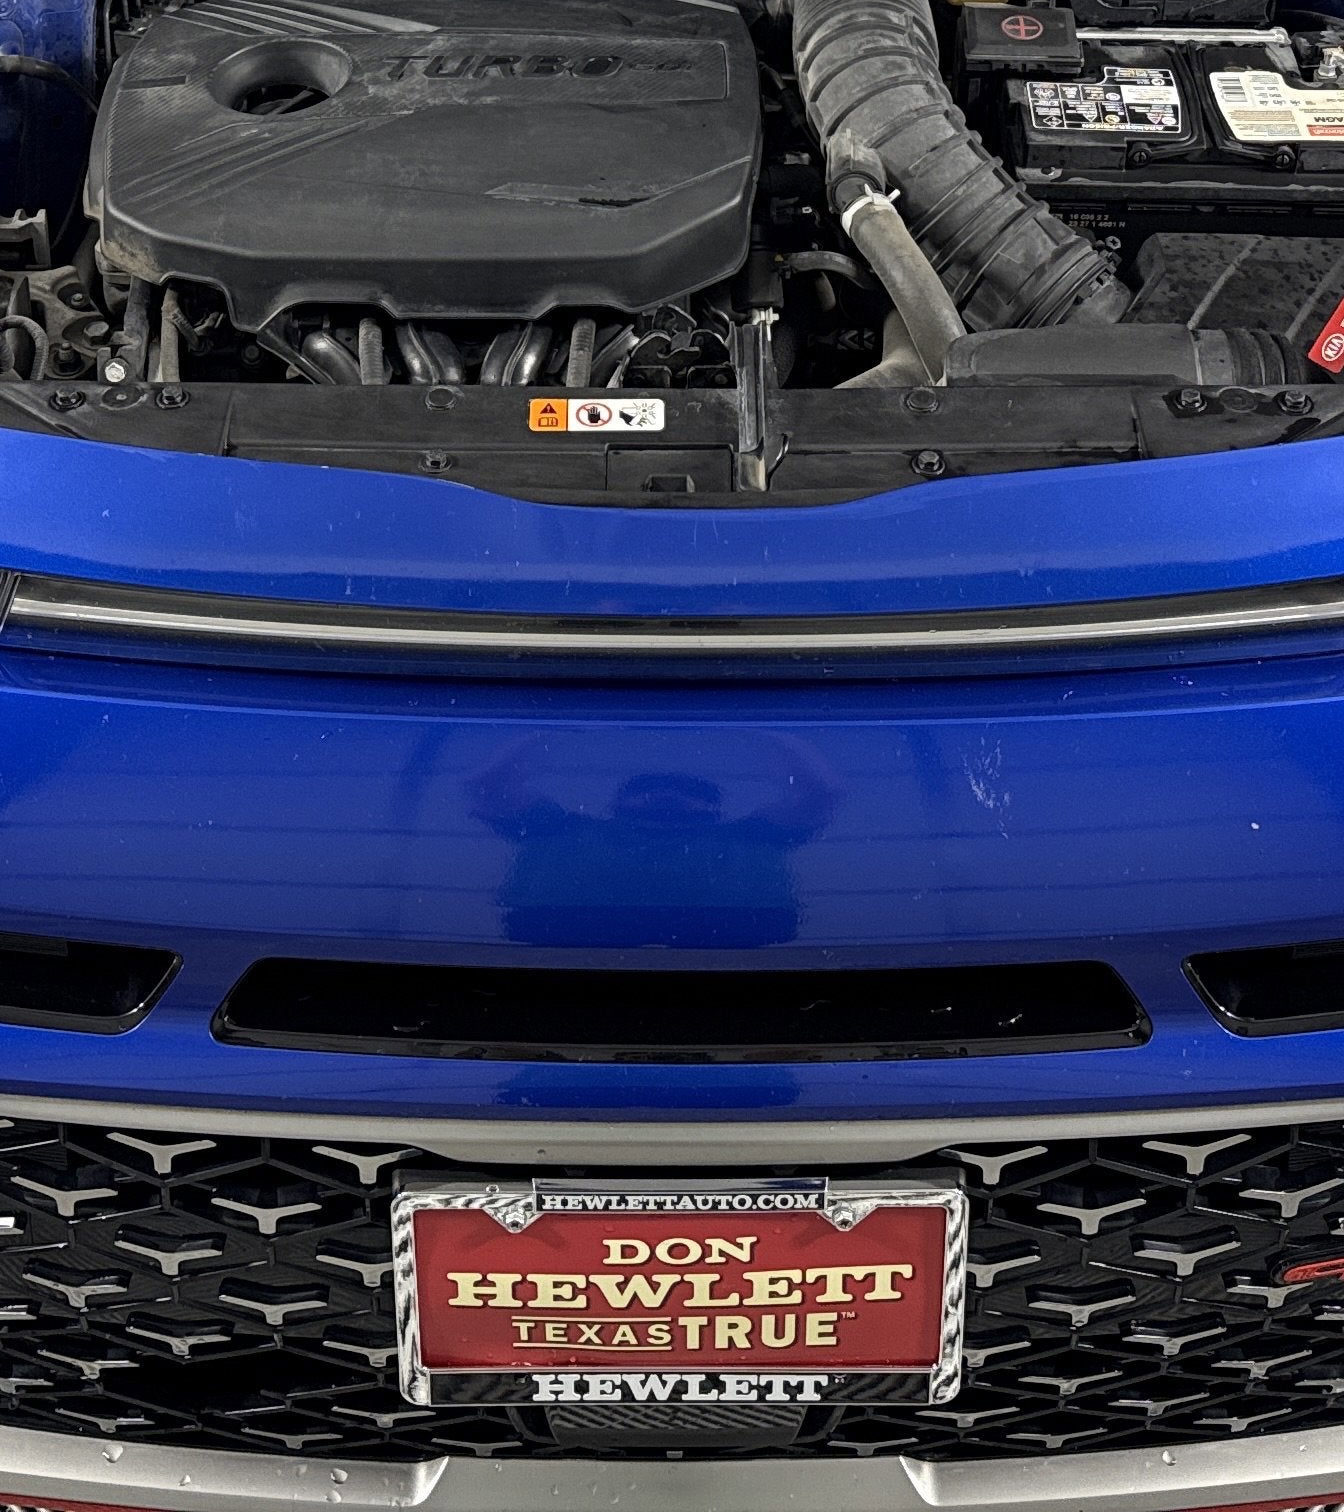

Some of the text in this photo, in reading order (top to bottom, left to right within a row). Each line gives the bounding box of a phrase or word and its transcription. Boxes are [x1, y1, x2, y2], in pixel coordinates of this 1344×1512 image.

[383, 55, 623, 81] TURBO
[1323, 337, 1344, 359] KIA
[541, 1193, 819, 1211] HEWLETTAUTO.COM
[602, 1235, 758, 1266] DON
[446, 1263, 914, 1310] HEWLETT
[531, 1373, 829, 1402] HEWLETT
